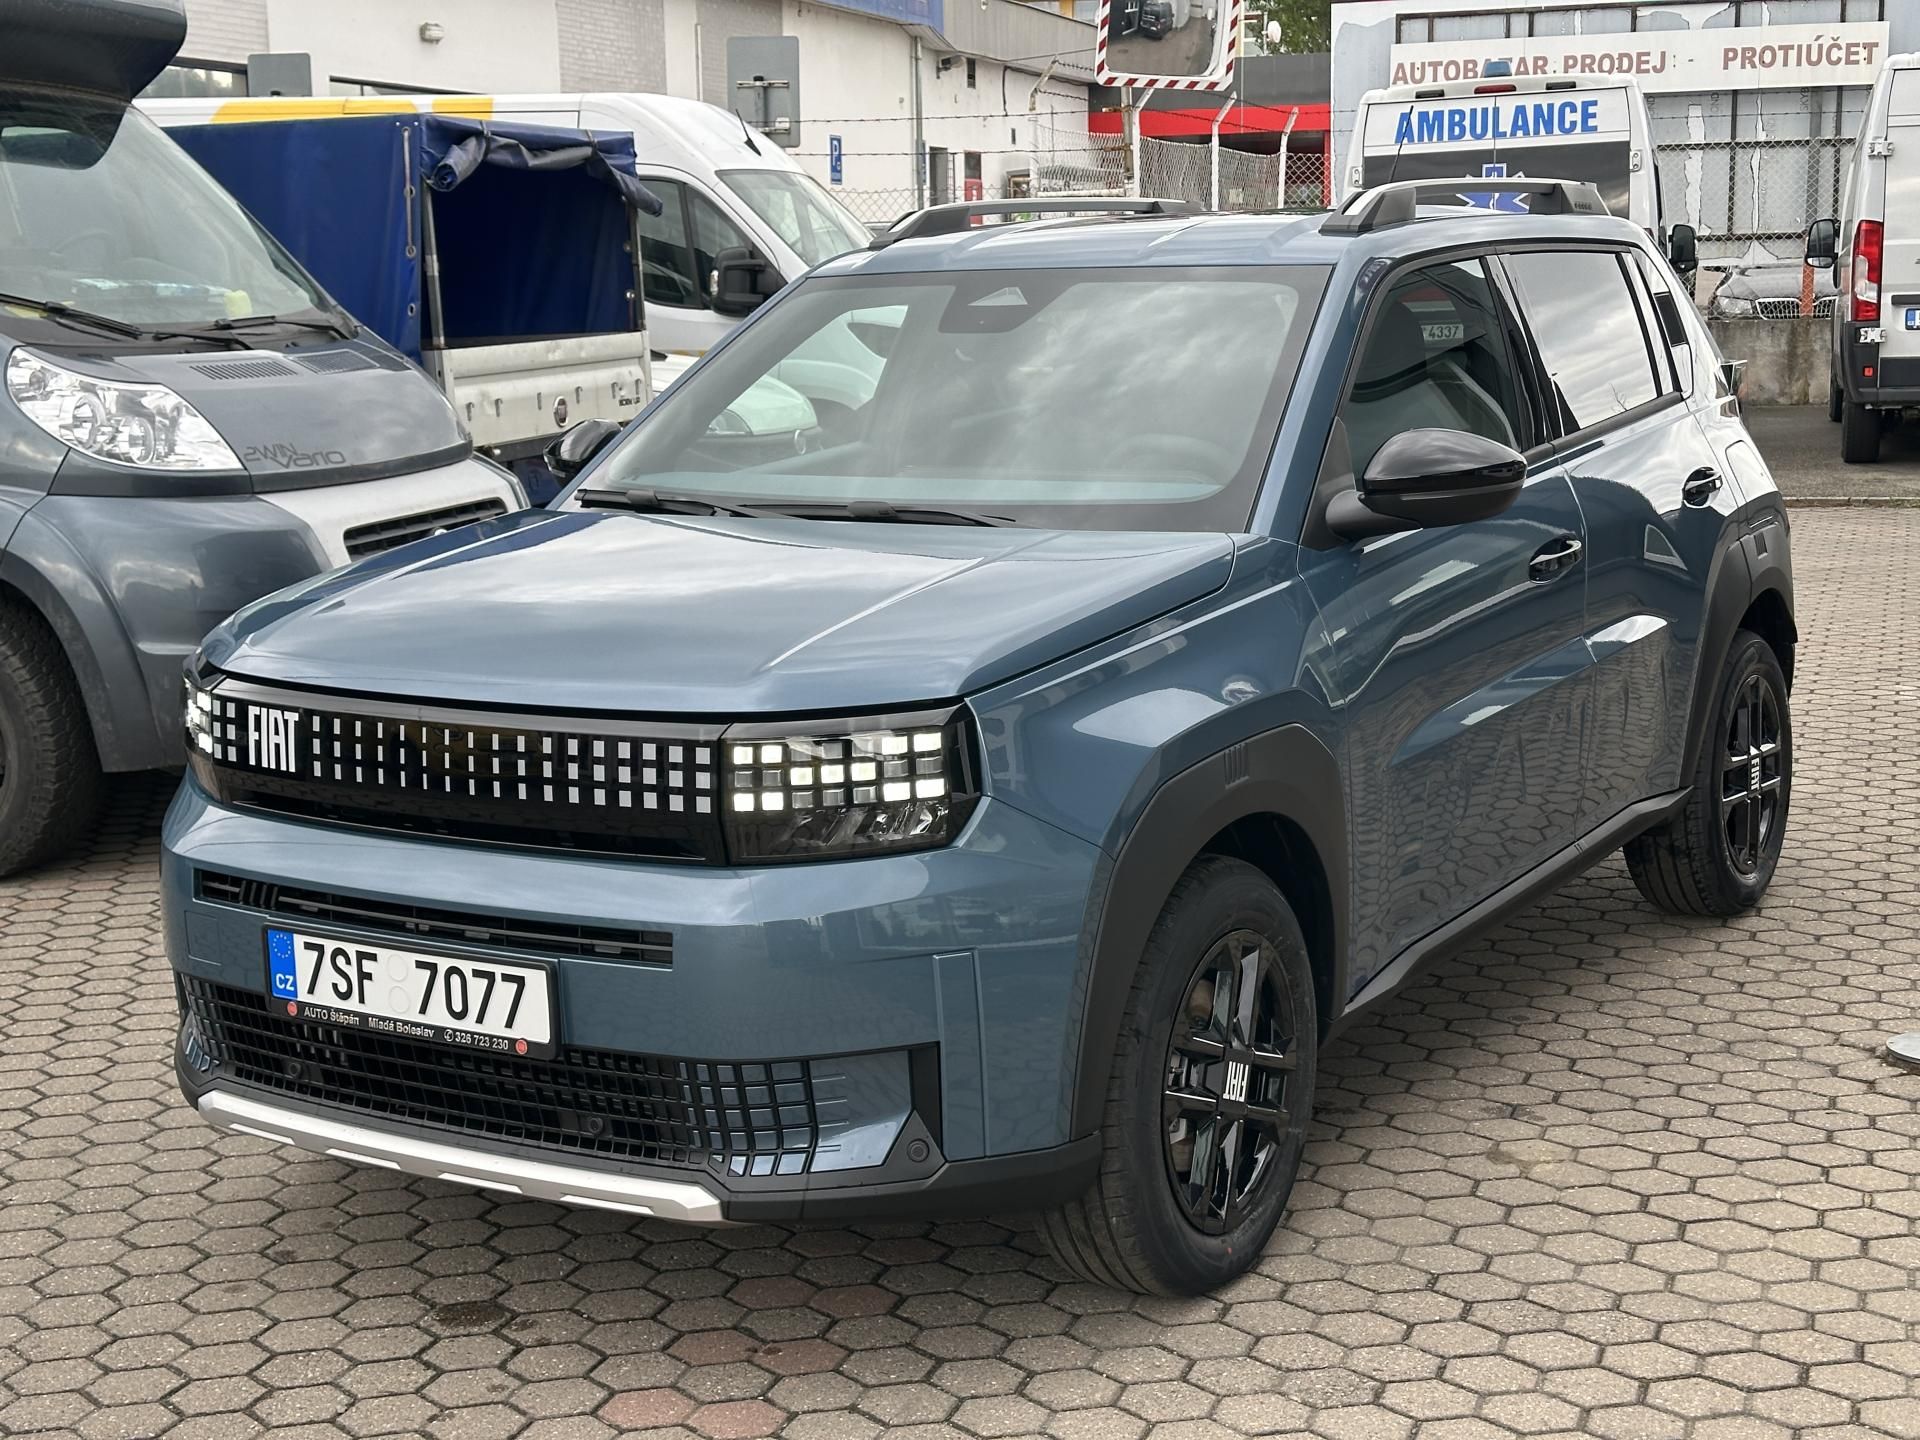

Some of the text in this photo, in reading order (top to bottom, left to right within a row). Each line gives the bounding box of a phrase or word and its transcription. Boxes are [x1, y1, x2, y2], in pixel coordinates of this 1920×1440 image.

[1391, 55, 1549, 85] AUTOBAR
[1563, 51, 1667, 75] PRODEJ
[1722, 35, 1879, 70] PROTIÚČET
[1394, 99, 1598, 144] AMBULANCE
[1428, 326, 1459, 339] 4337
[248, 705, 299, 773] FIAT
[1752, 758, 1760, 790] FIAT
[275, 973, 295, 991] CZ
[303, 941, 526, 1029] 7SF 7077
[304, 1006, 509, 1050] AUTO Štěpán Mladá Boleslav 326 723 230
[1223, 1061, 1248, 1101] FIAT
